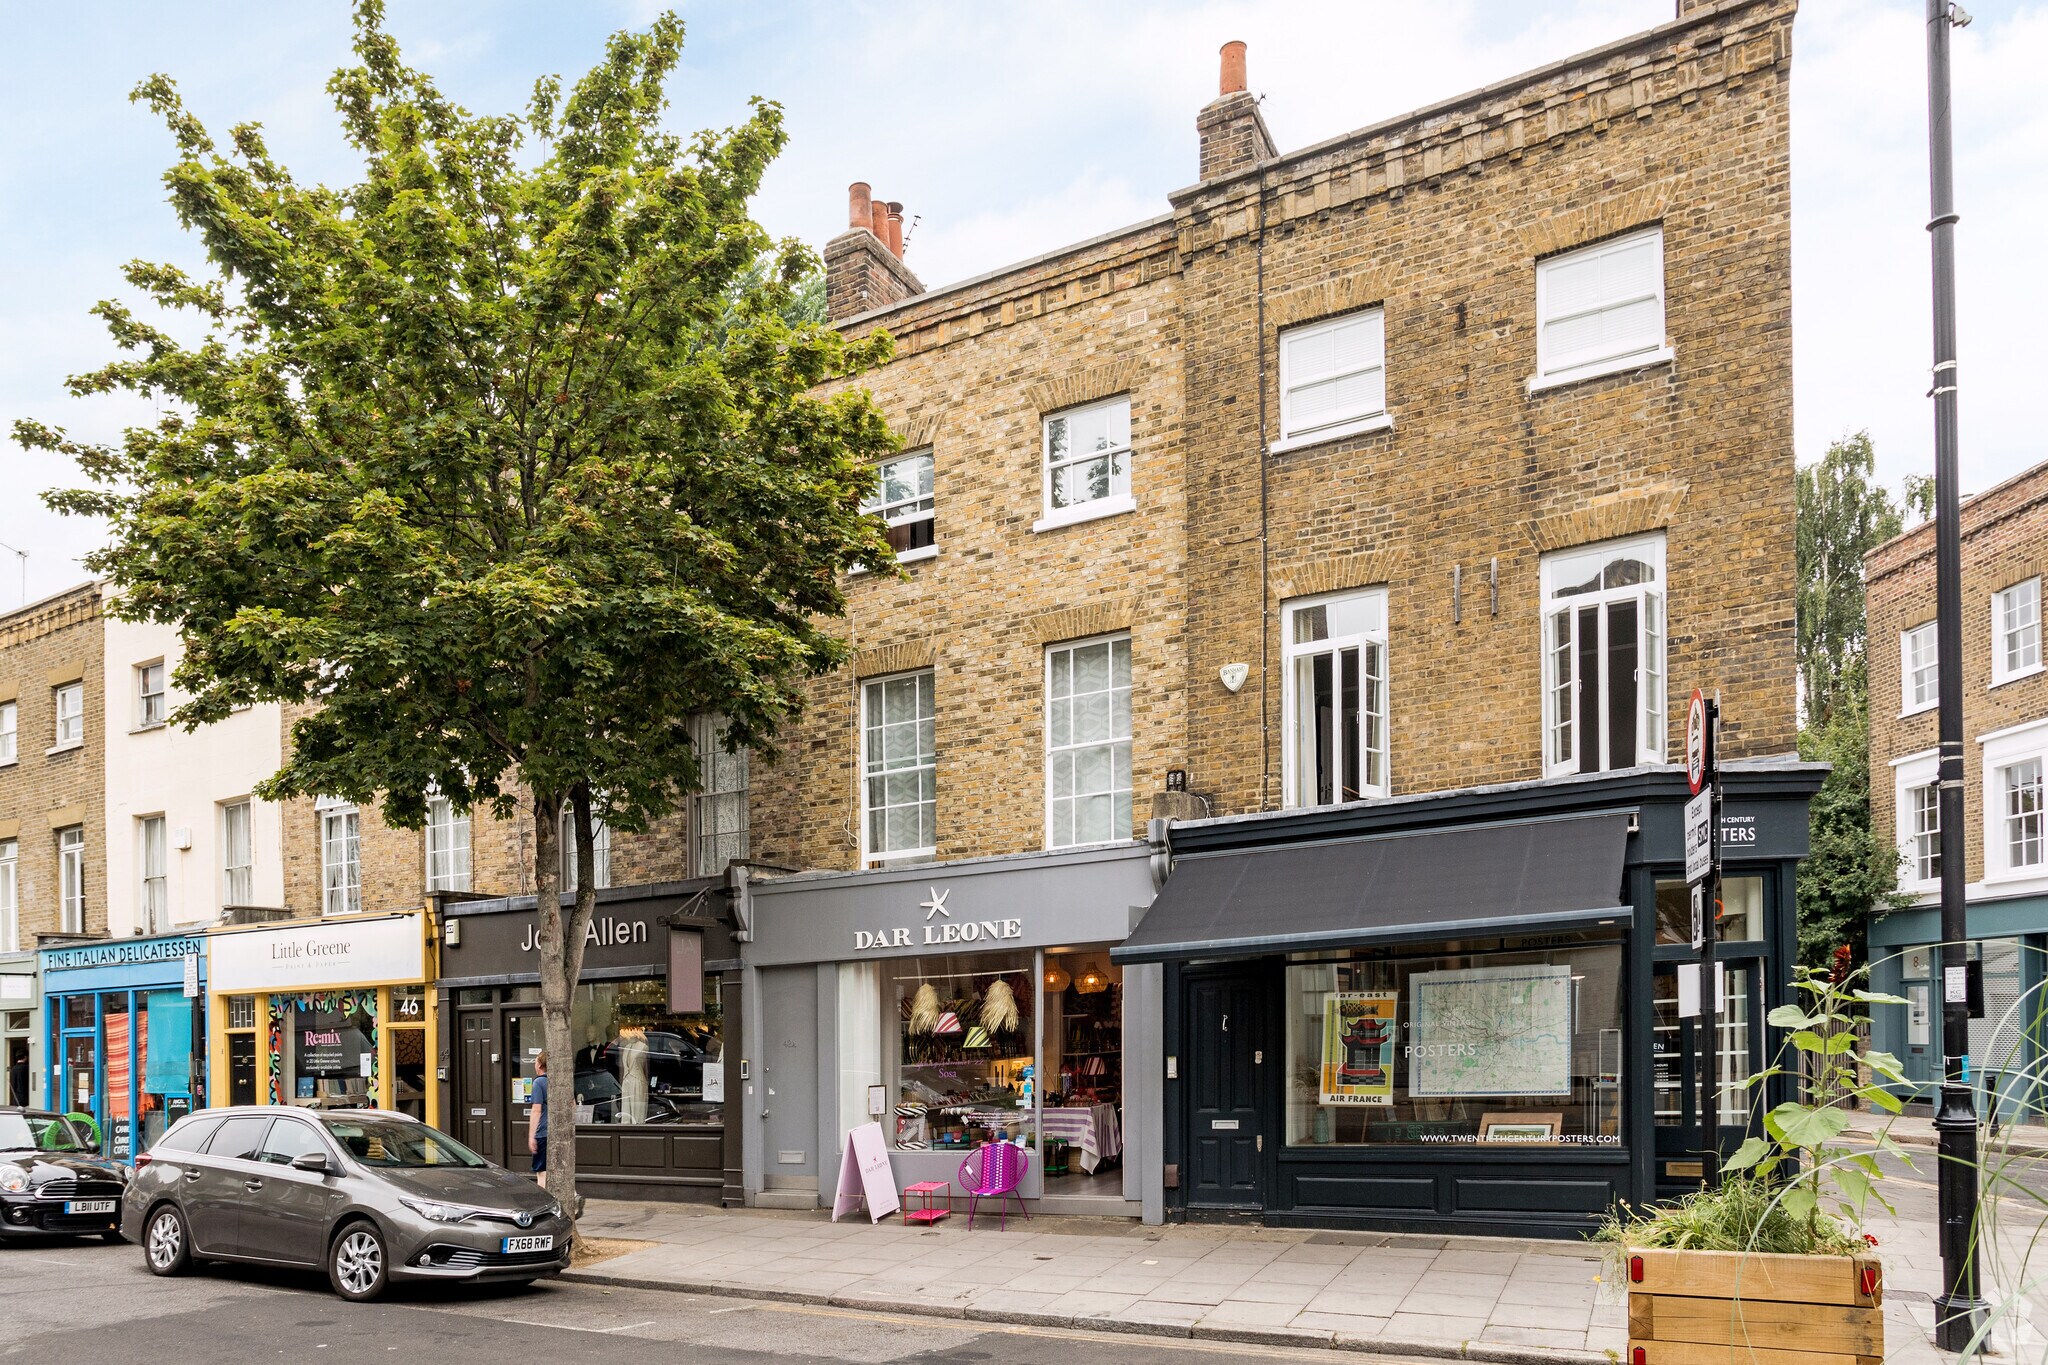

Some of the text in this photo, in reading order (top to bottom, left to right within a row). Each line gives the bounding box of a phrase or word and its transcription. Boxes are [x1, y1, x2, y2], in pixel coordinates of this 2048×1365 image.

[1721, 827, 1756, 842] TERS
[584, 917, 647, 947] Allen
[854, 918, 1022, 950] DAR LEONE
[1521, 935, 1571, 947] POSTERS
[48, 940, 201, 968] FINE ITALIAN DELICATESSEN
[272, 940, 351, 959] Little Greene
[400, 996, 418, 1015] 46
[1402, 1021, 1440, 1029] ORIGINAL
[305, 1029, 341, 1046] Re:mix
[1404, 1043, 1476, 1058] POSTERS
[938, 1068, 957, 1078] Sosa
[1348, 1095, 1382, 1103] FRANCE
[1420, 1134, 1620, 1143] WWW.TWENTIETHCENTURYPOSTERS.COM
[113, 1145, 130, 1155] COFFE
[75, 1202, 111, 1211] LB11 UTF
[508, 1237, 551, 1250] FX68 RWF
